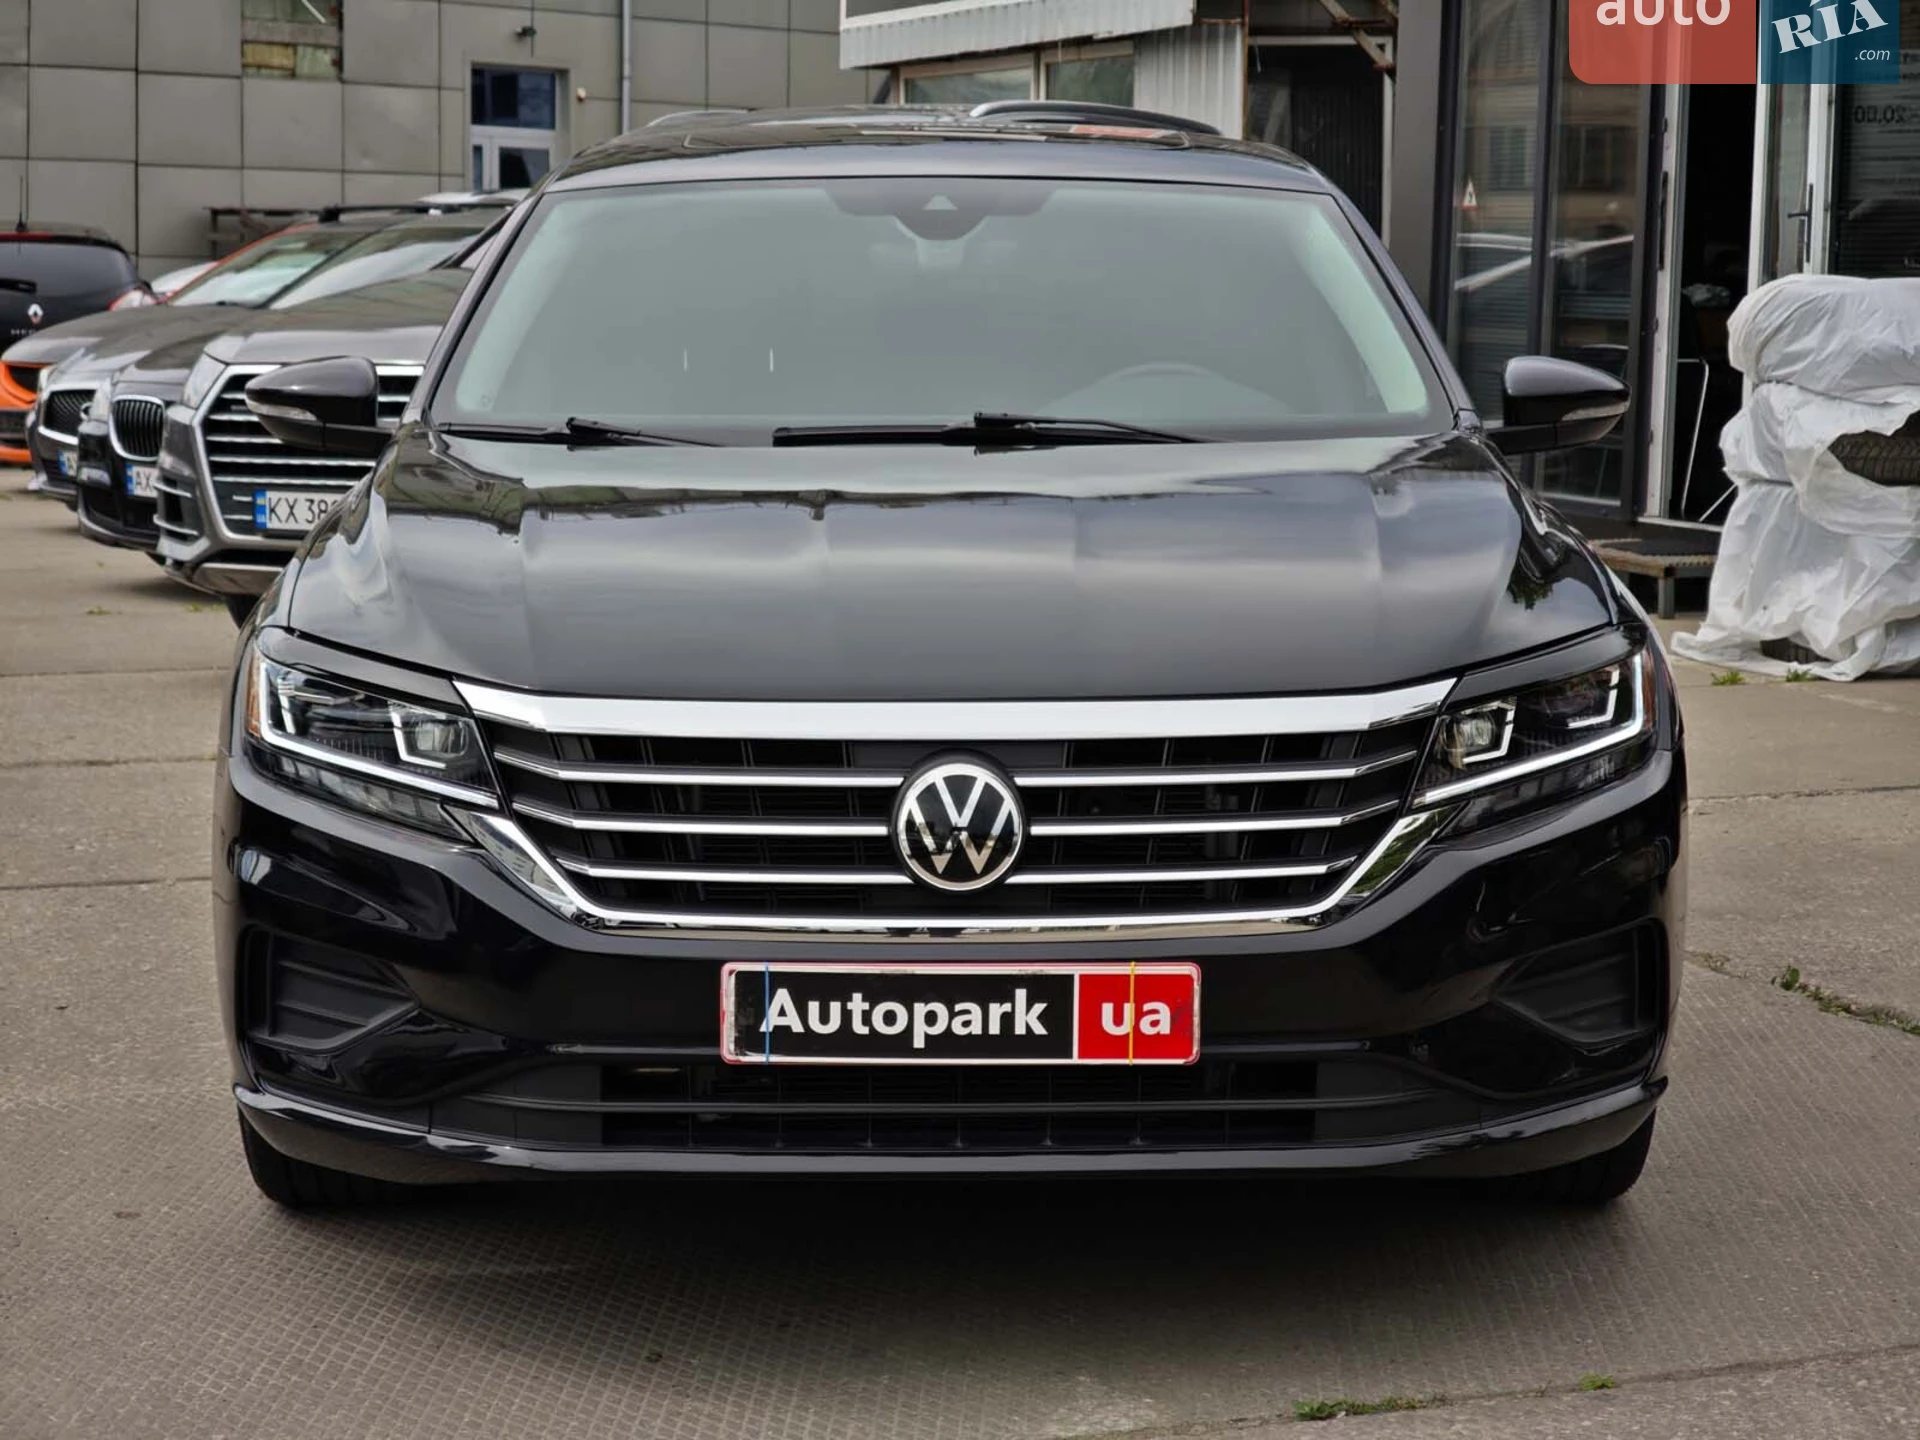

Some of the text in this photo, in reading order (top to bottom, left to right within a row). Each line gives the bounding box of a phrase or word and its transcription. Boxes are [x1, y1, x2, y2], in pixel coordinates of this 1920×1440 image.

[268, 496, 338, 525] KX 38
[759, 988, 1172, 1049] Autopark ua
